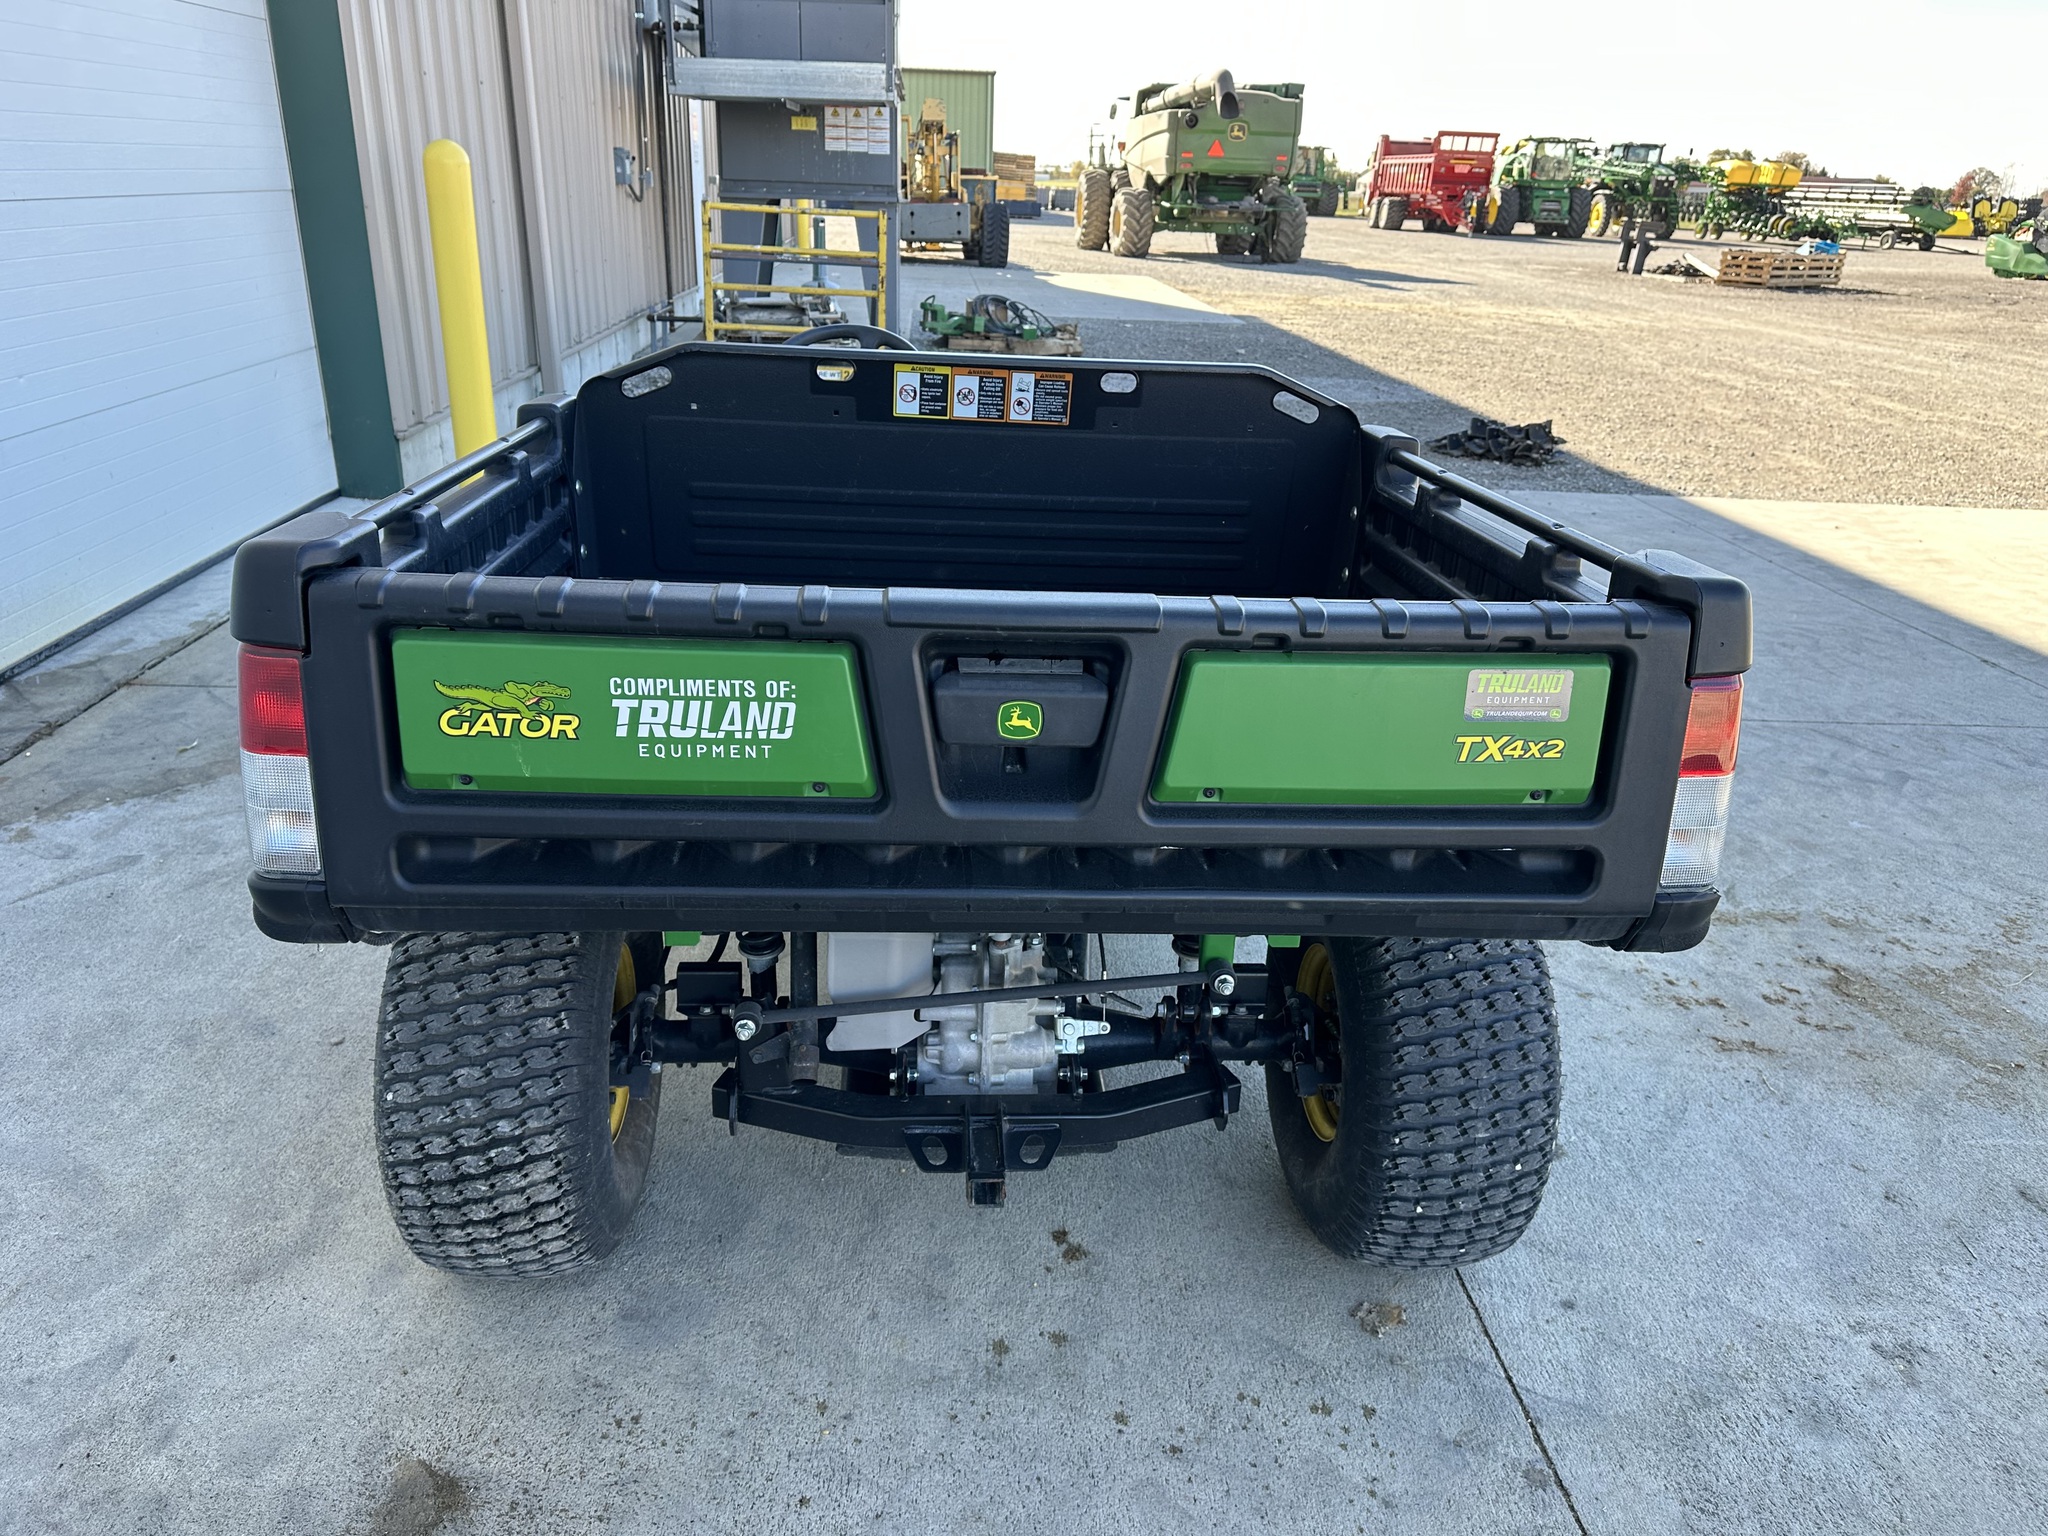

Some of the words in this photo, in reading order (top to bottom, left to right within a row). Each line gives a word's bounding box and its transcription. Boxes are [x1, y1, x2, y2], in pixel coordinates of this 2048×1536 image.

[610, 677, 756, 698] COMPLIMENTS
[766, 680, 796, 698] OF:
[1478, 674, 1564, 693] TRULAND
[1486, 696, 1550, 704] EQUIPMENT
[439, 709, 580, 740] GATOR
[611, 698, 796, 740] TRULAND
[639, 743, 772, 758] EQUIPMENT
